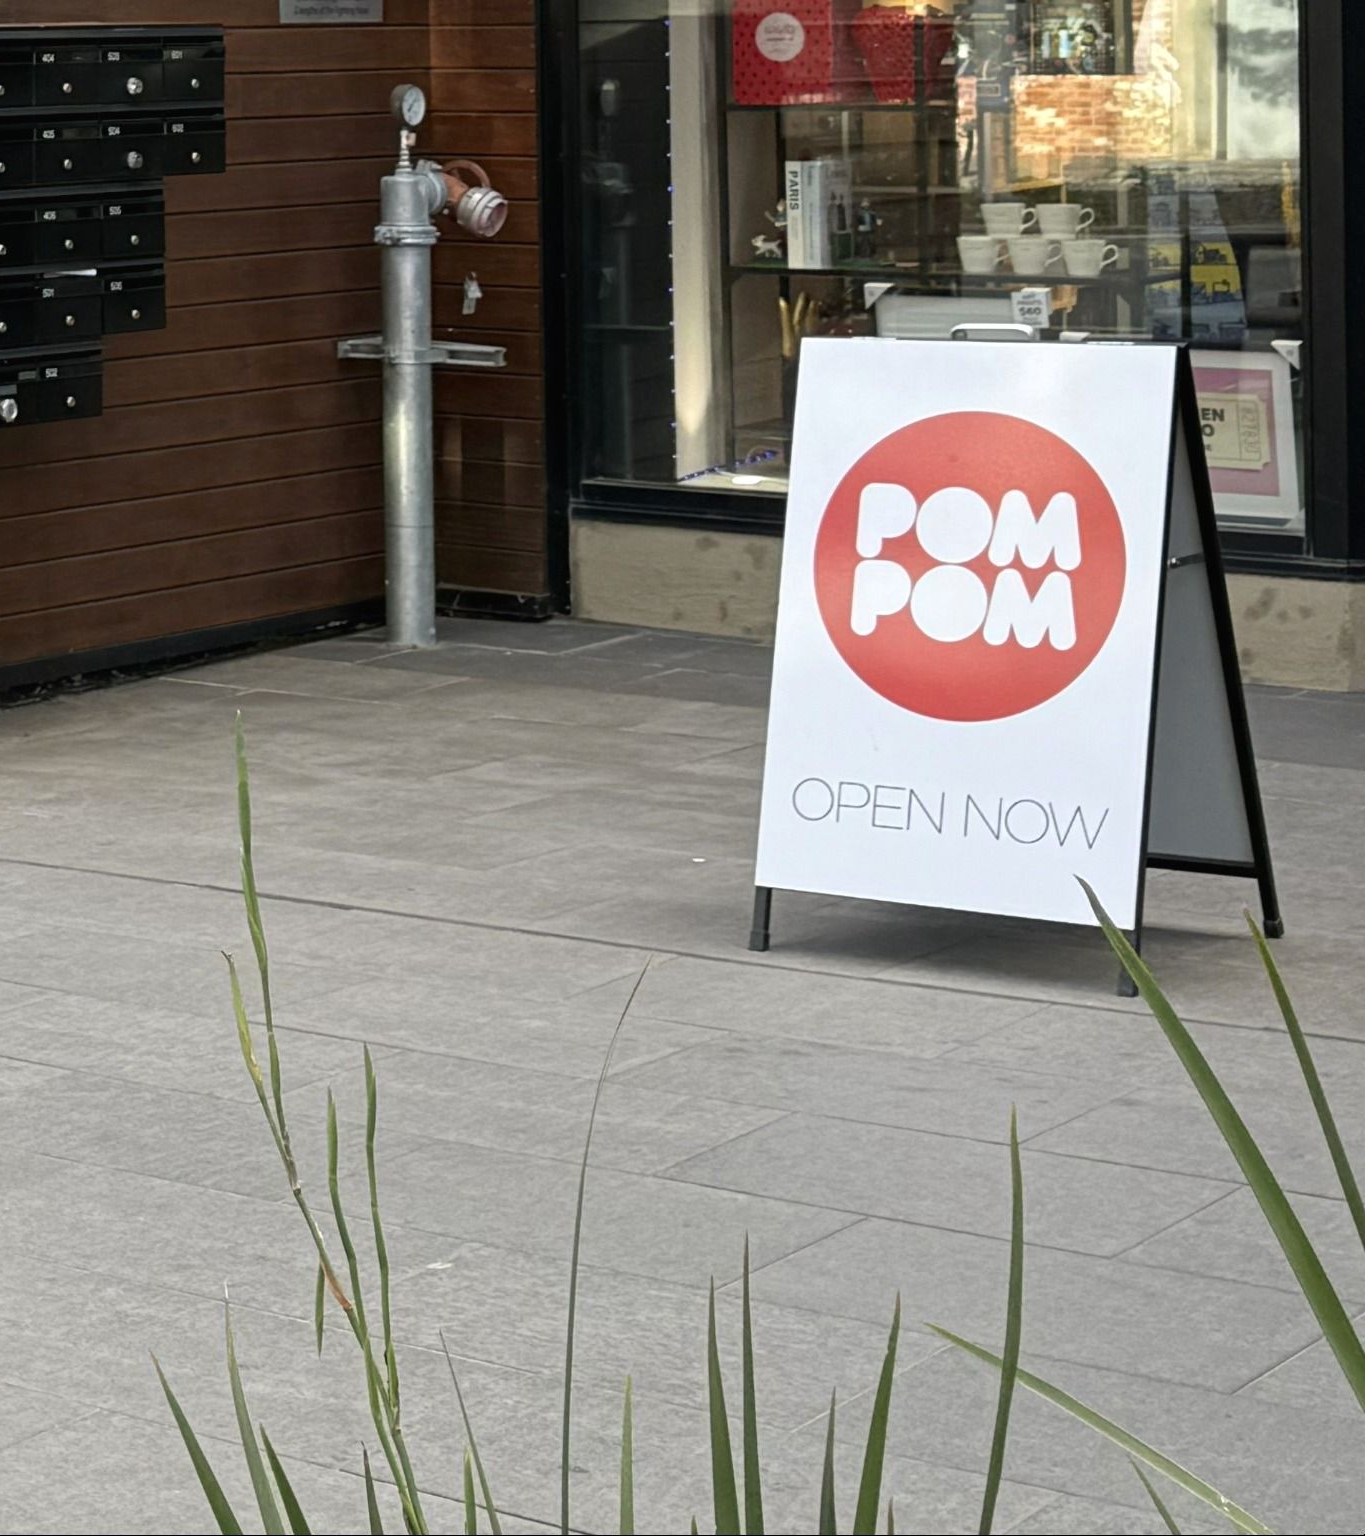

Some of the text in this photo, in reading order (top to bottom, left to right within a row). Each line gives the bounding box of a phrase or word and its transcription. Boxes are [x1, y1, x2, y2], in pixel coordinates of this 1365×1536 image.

[787, 170, 800, 211] PARIS
[855, 482, 1082, 571] POM
[850, 559, 1077, 651] POM
[792, 777, 1110, 850] OPEN NOW
